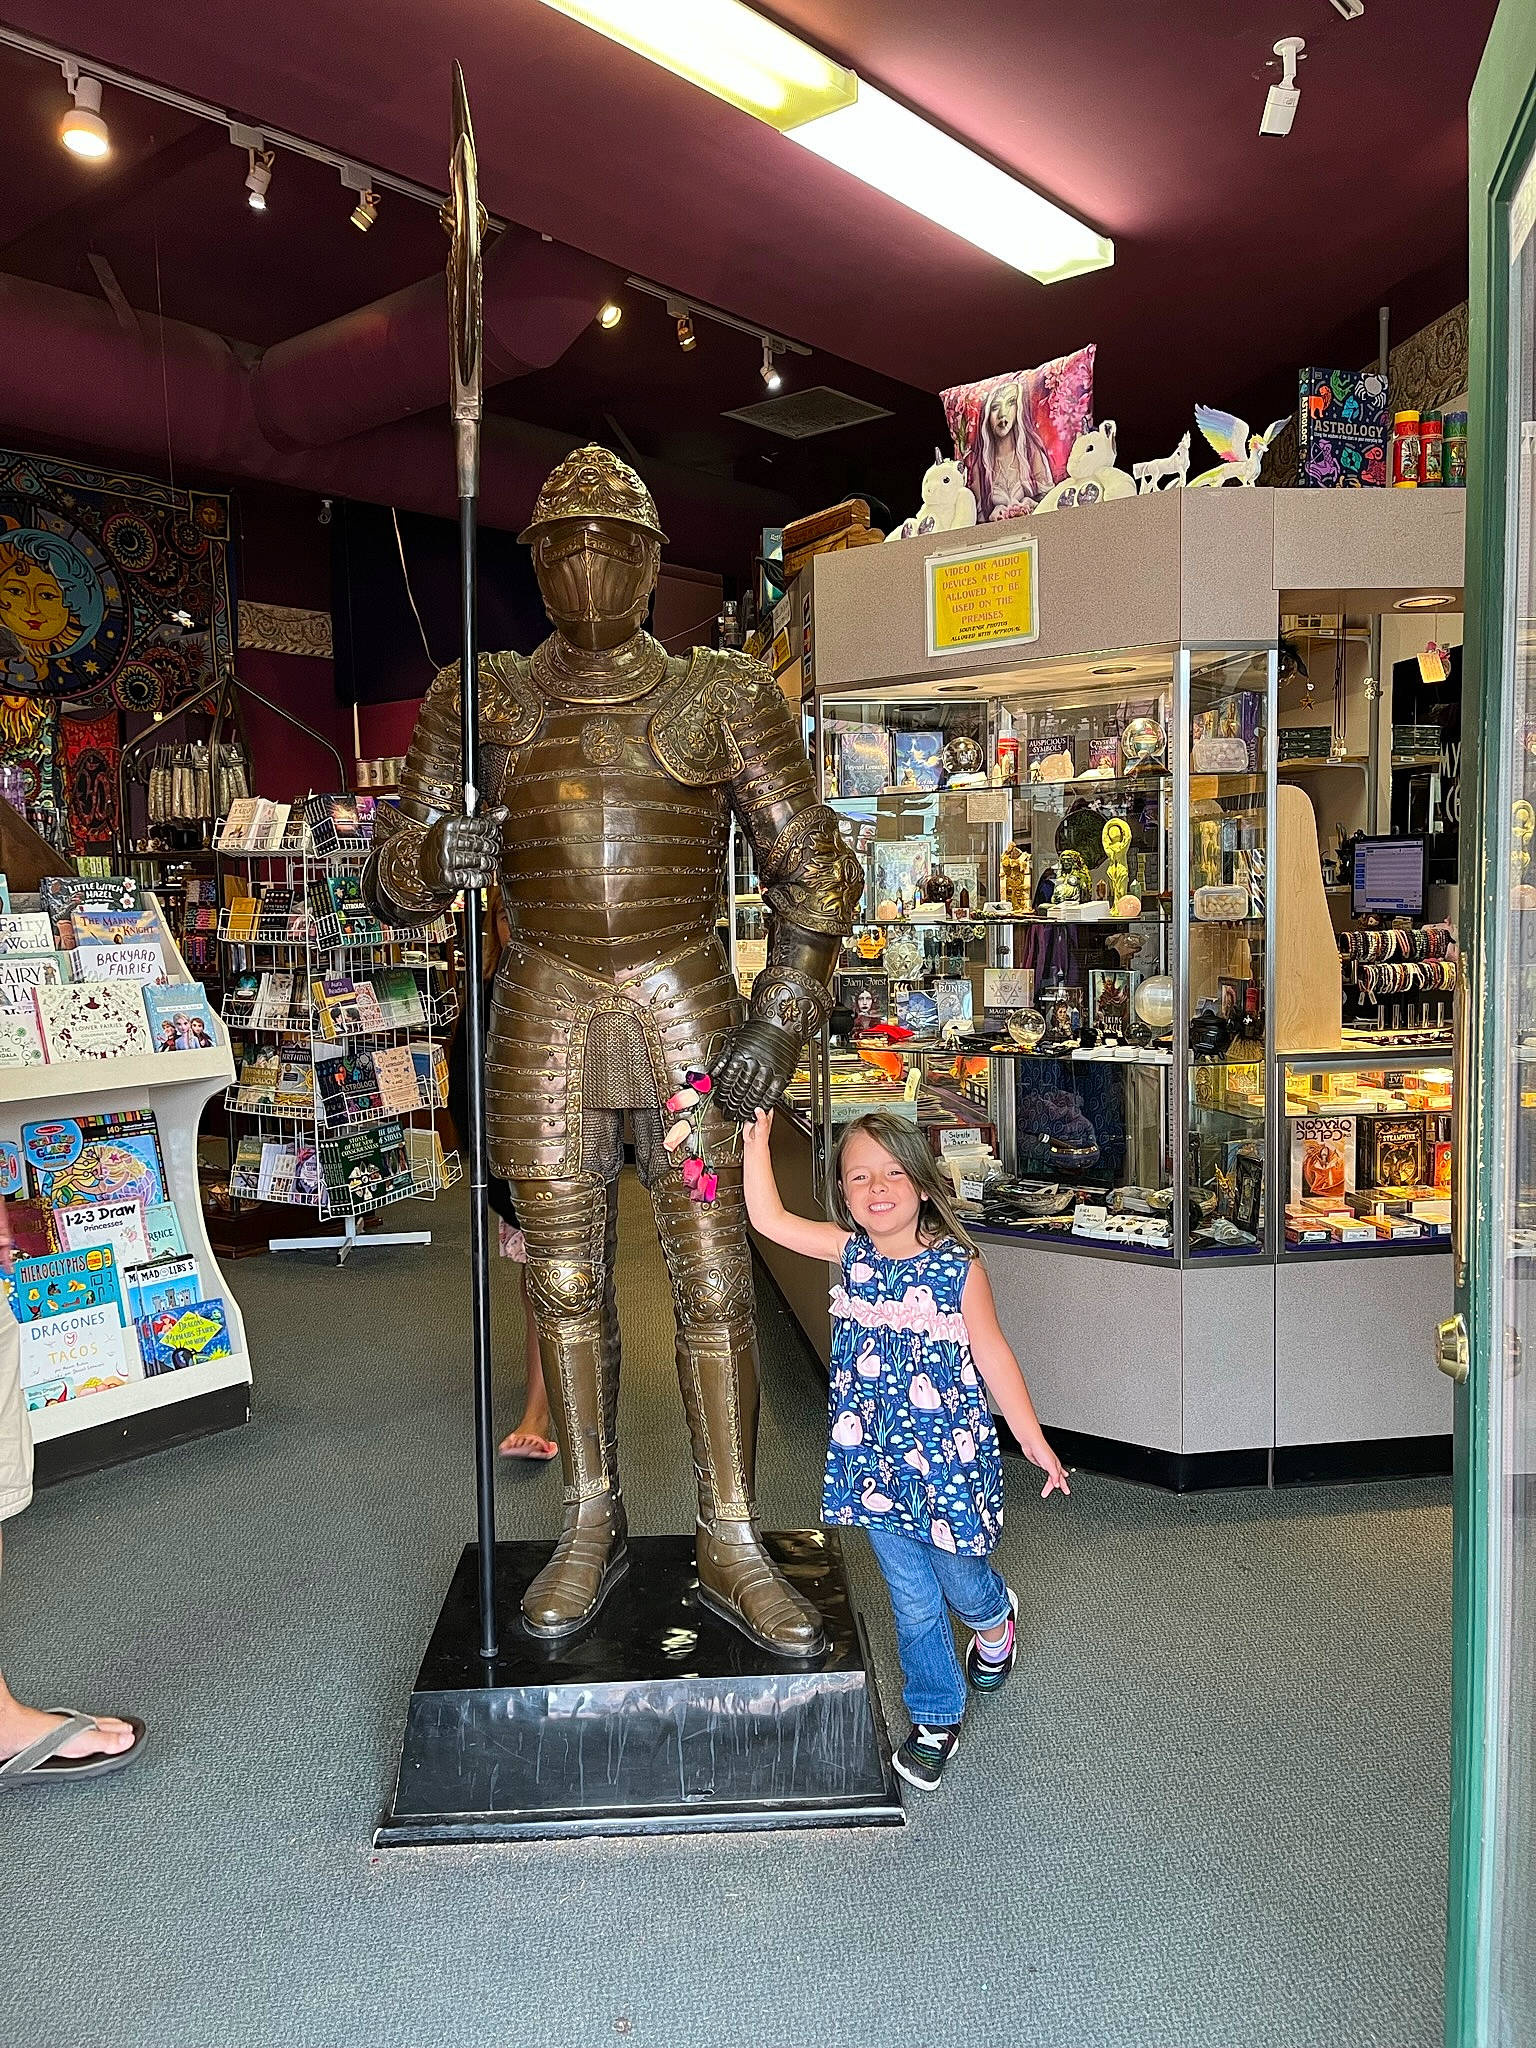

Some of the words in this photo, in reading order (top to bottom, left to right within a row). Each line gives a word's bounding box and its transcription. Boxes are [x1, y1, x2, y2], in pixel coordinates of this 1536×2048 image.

[1313, 420, 1384, 438] ASTROLOGY
[944, 565, 970, 577] VIDEO
[974, 562, 987, 571] OR
[991, 556, 1020, 568] AUDIO
[942, 577, 977, 590] DEVICES
[981, 572, 1000, 583] ARE
[1004, 568, 1023, 579] NOT
[946, 587, 987, 602] ALLOWED
[992, 585, 1004, 594] TO
[1008, 582, 1020, 591] BE
[952, 602, 975, 614] USED
[979, 600, 992, 609] ON
[996, 595, 1013, 605] THE
[961, 610, 1004, 624] PREMISES
[951, 633, 976, 641] ALLOWED
[1029, 737, 1066, 748] AUSPICIOUS
[1032, 744, 1062, 753] SYMBOLS
[67, 882, 95, 894] LITTLE
[95, 882, 123, 893] WITCH
[85, 890, 113, 899] HAZEL
[0, 917, 46, 936] Fairy
[80, 916, 99, 926] THE
[102, 916, 138, 926] MAKING
[122, 926, 154, 936] KNIGHT
[5, 934, 50, 949] World
[97, 949, 156, 966] BACKYARD
[109, 963, 153, 976] FAIRIES
[938, 982, 969, 993] RUNES
[1104, 1016, 1122, 1024] IKING
[341, 1080, 376, 1092] ASTROLOGY
[349, 1135, 367, 1143] STONES
[66, 1211, 95, 1226] 1-2-3
[98, 1204, 136, 1220] Draw
[84, 1220, 124, 1232] Princesses
[148, 1228, 175, 1242] RENCE
[20, 1255, 86, 1284] HIEROGLYPHS
[140, 1269, 160, 1281] MAD
[169, 1264, 187, 1275] LIBS
[31, 1312, 105, 1341] DRAGONES
[48, 1342, 98, 1364] TACOS
